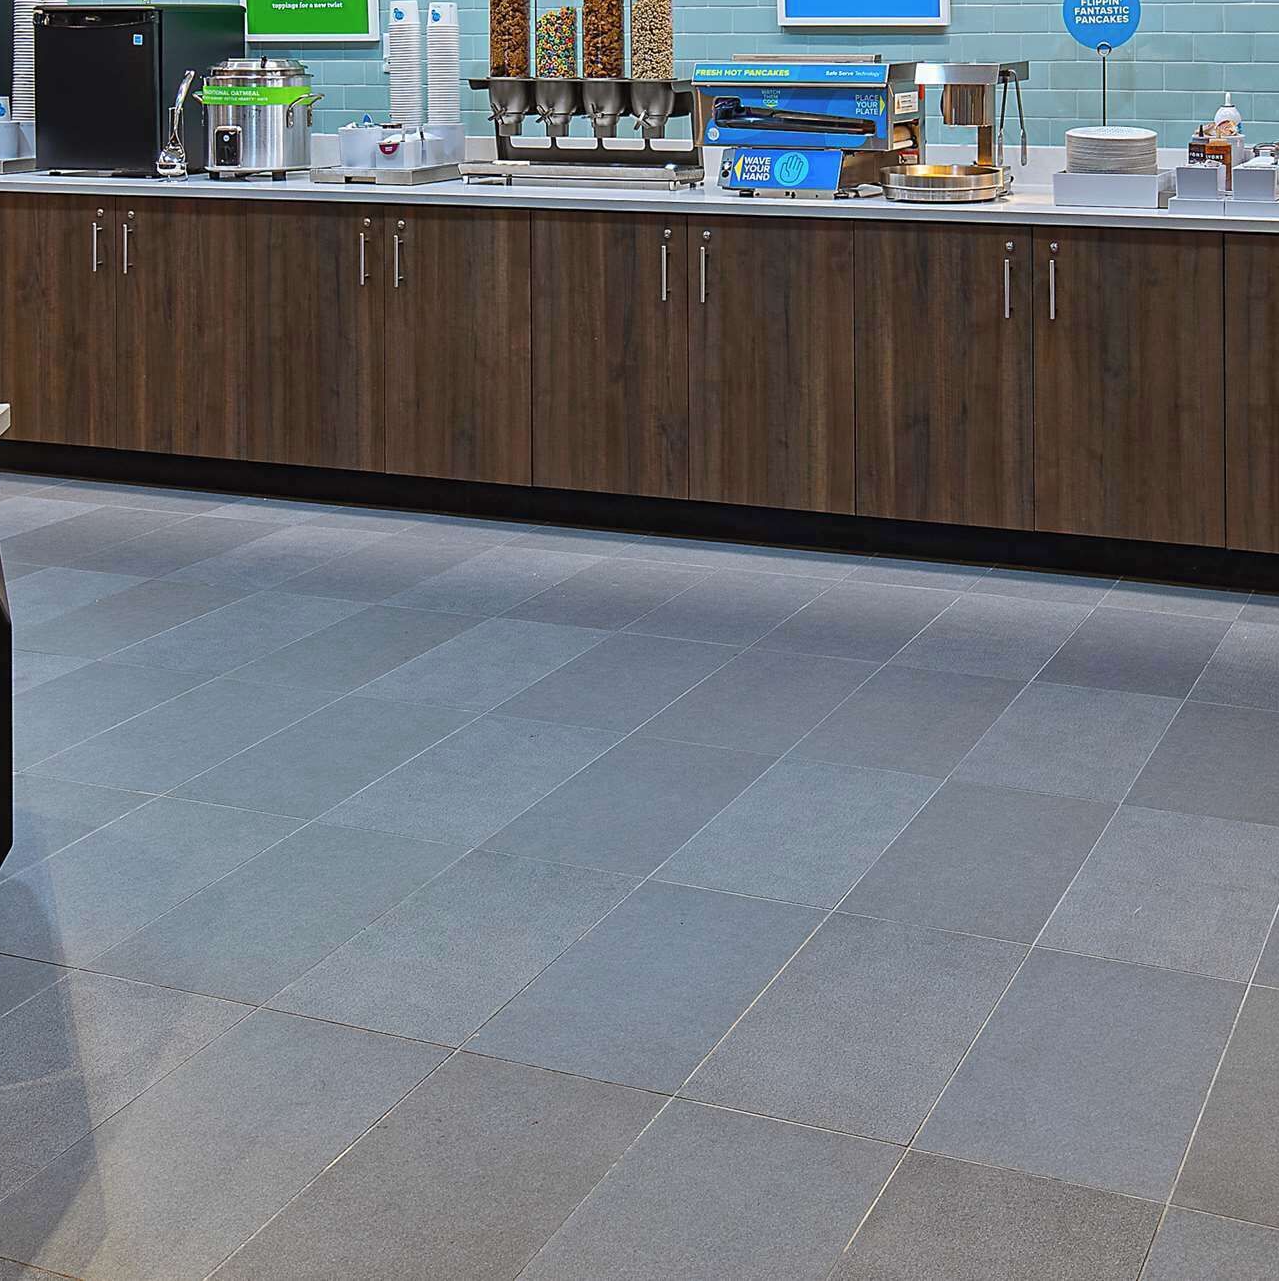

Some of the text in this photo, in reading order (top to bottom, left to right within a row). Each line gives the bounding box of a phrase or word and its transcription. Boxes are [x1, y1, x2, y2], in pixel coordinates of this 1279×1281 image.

[272, 2, 299, 10] toppings
[1074, 6, 1130, 15] FANTASTIC
[1075, 15, 1130, 24] PANCAKES
[695, 69, 722, 77] FRESH
[744, 69, 790, 77] PANCAKES
[743, 156, 771, 165] WAVE
[744, 164, 771, 173] YOUR
[743, 172, 770, 181] HAND
